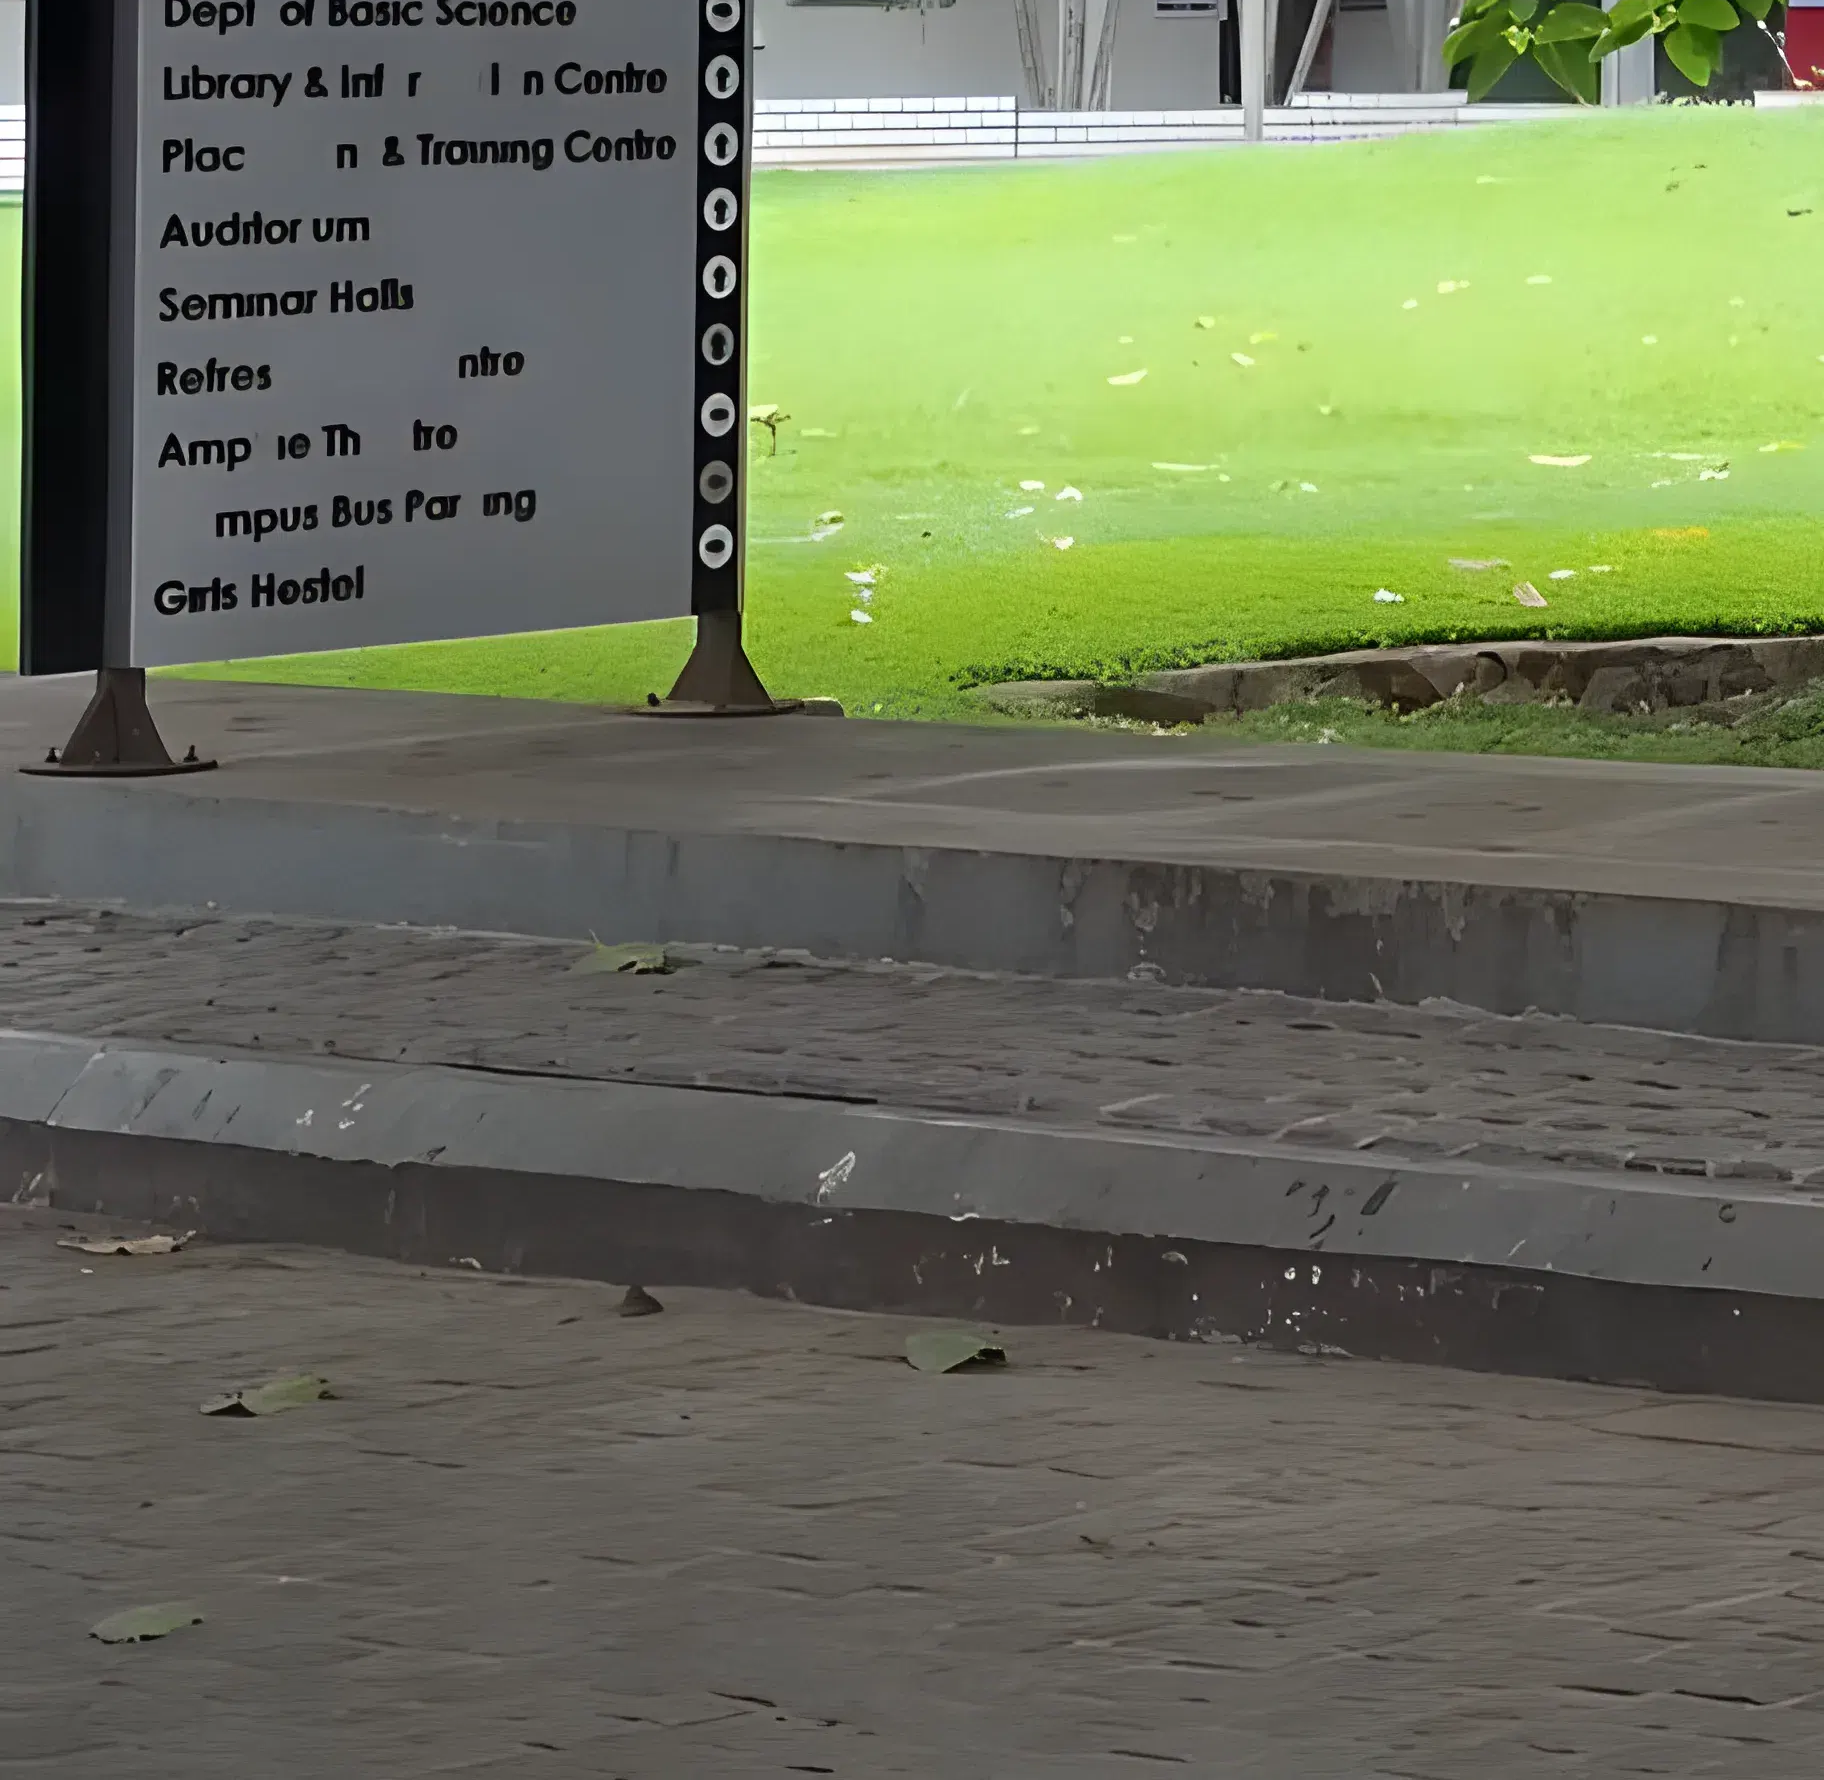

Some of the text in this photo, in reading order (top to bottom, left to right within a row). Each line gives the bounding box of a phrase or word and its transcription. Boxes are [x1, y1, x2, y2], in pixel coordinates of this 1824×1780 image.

[163, 63, 293, 108] Library
[303, 65, 329, 99] &
[381, 135, 406, 167] &
[158, 276, 415, 323] Seminar Halls
[331, 494, 394, 529] Bus
